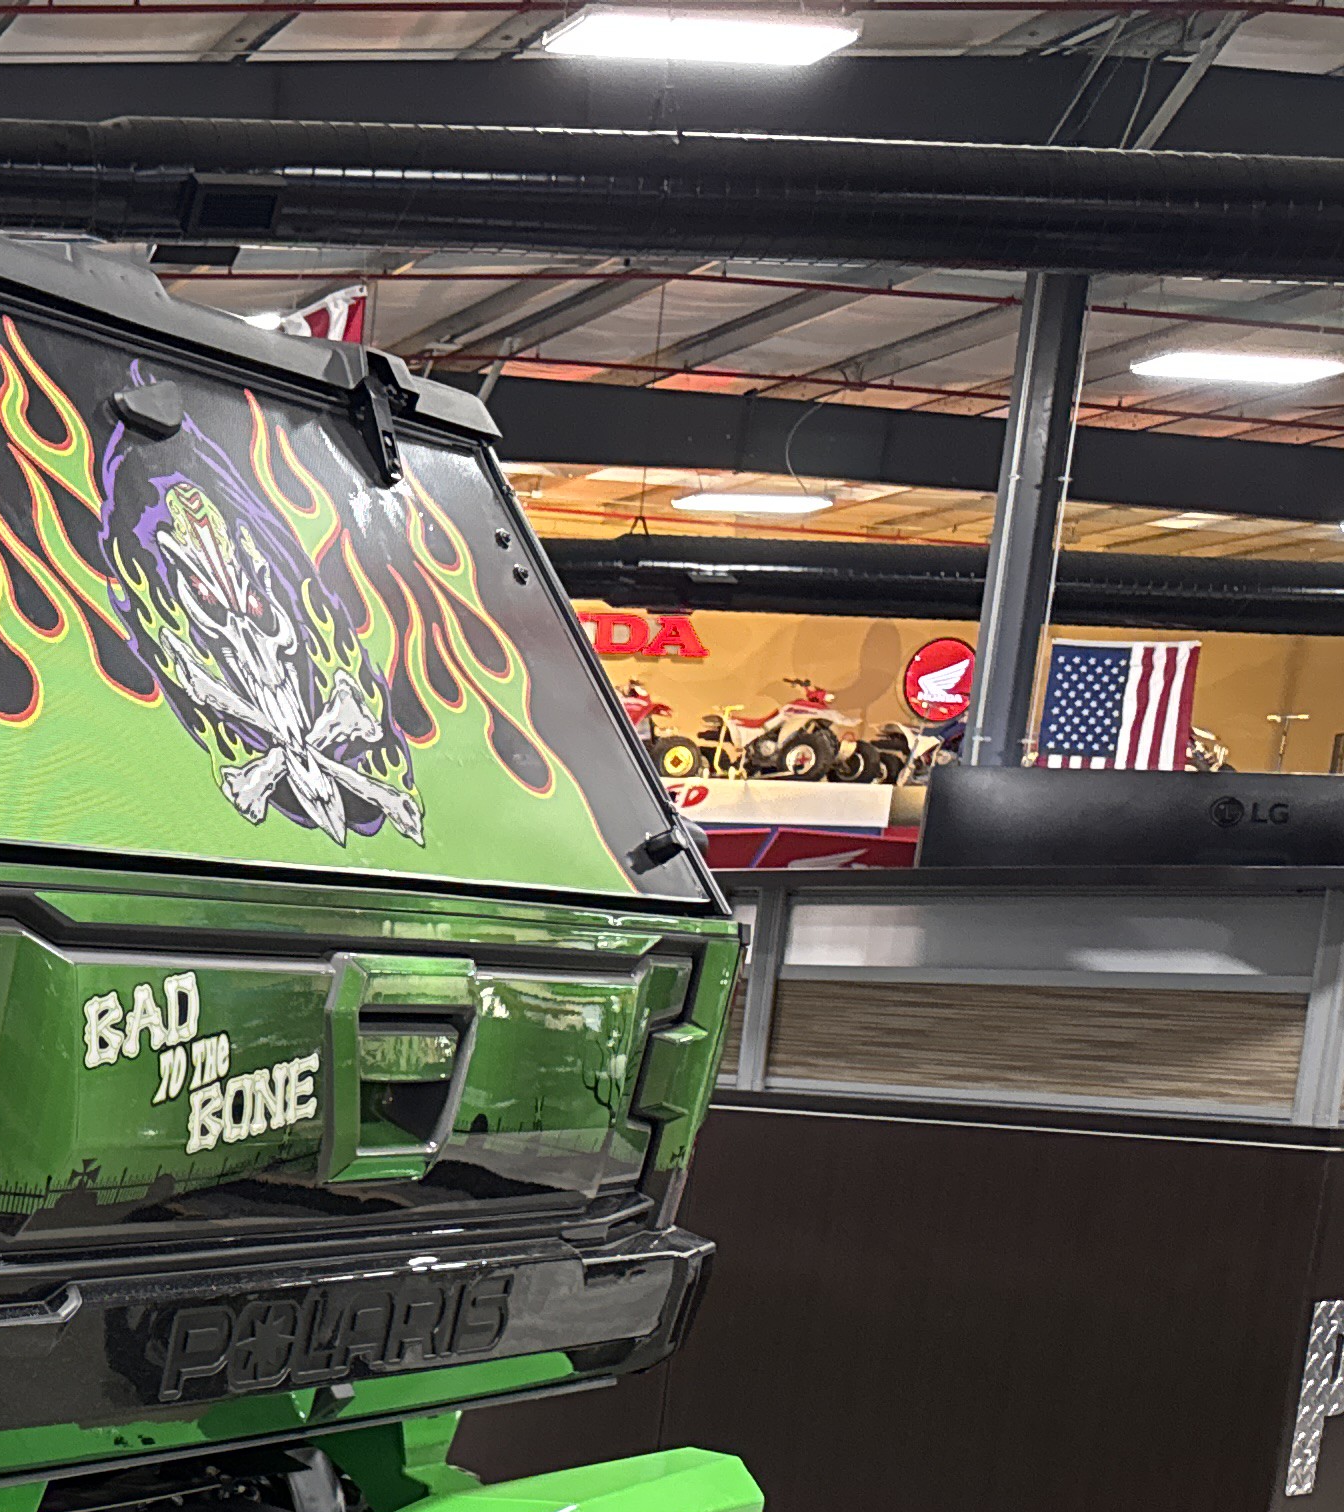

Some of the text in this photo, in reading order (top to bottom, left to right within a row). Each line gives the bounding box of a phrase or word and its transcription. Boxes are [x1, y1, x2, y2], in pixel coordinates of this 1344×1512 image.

[580, 612, 710, 658] DA
[1250, 802, 1290, 825] LG
[83, 970, 200, 1070] BAD
[152, 1045, 188, 1107] TO
[186, 1053, 321, 1155] BONE
[160, 1269, 514, 1401] POLARIS
